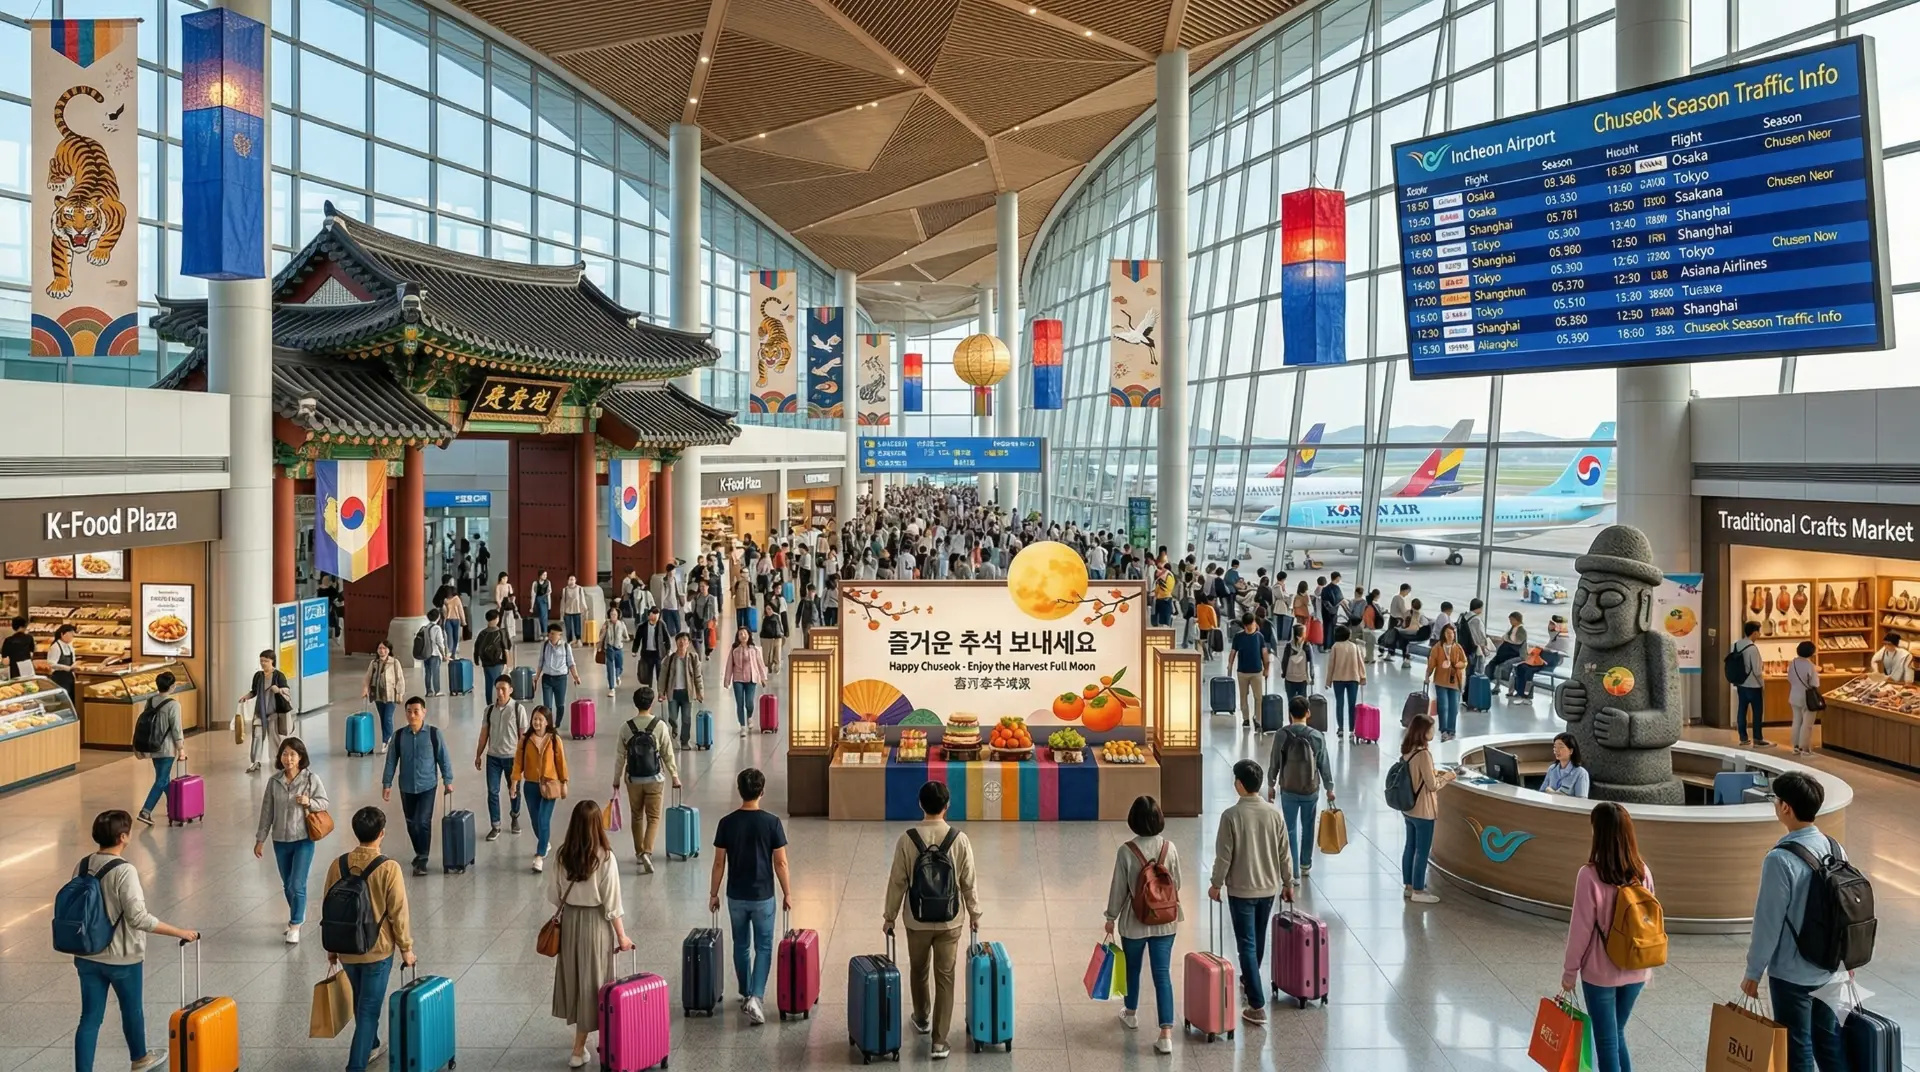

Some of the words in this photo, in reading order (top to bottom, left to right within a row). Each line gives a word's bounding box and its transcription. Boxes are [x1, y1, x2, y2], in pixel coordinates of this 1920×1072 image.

[1594, 101, 1663, 134] Chuseok
[1667, 89, 1729, 119] Season
[1734, 73, 1794, 104] Traffic
[1799, 63, 1838, 91] Info
[1763, 112, 1802, 129] Season
[1451, 142, 1503, 164] Incheon
[1506, 129, 1557, 153] Airport
[1671, 131, 1703, 147] Flight
[1467, 190, 1495, 203] Osaka
[1672, 151, 1708, 166] Osaka
[1764, 133, 1805, 149] Chusen
[1542, 158, 1573, 171] Season
[1468, 206, 1497, 219] Osaka
[1673, 170, 1709, 185] Tokyo
[1469, 219, 1513, 237] Shanghai
[1546, 209, 1578, 223] 05.781
[1675, 185, 1723, 203] Ssakana
[1767, 173, 1806, 188] Chusen
[1471, 240, 1501, 254] Tokyo
[1676, 204, 1731, 222] Shanghai
[1471, 252, 1516, 269] Shanghai
[1611, 236, 1638, 248] 12:50
[1678, 221, 1733, 240] Shanghai
[1473, 273, 1501, 285] Tokyo
[1679, 245, 1715, 260] Tokyo
[1772, 233, 1811, 248] Chusen
[1814, 230, 1838, 243] Now
[1475, 286, 1526, 302] Shangchun
[1680, 264, 1720, 278] Asiana
[1723, 258, 1767, 275] Airlines
[1476, 306, 1504, 319] Tokyo
[1553, 296, 1586, 310] 05.510
[1476, 319, 1520, 334] Shanghai
[1683, 298, 1738, 316] Shanghai
[1684, 319, 1729, 334] Chuseok
[1732, 316, 1773, 330] Season
[1776, 311, 1814, 326] Traffic
[1817, 309, 1842, 323] Info
[47, 507, 121, 539] K-Food
[127, 506, 178, 533] Plaza
[1392, 504, 1420, 515] AIR
[1718, 510, 1796, 534] Traditional
[1800, 515, 1847, 538] Crafts
[1852, 517, 1914, 542] Market
[888, 630, 953, 655] 즐거운
[959, 630, 1002, 655] 추석
[1009, 630, 1096, 655] 보내세요
[889, 661, 919, 673] Happy
[921, 661, 960, 671] Chuseok
[967, 661, 994, 673] Enjoy
[995, 661, 1011, 671] the
[1012, 661, 1048, 671] Harvest
[1050, 661, 1067, 671] Full
[1069, 661, 1096, 671] Moon
